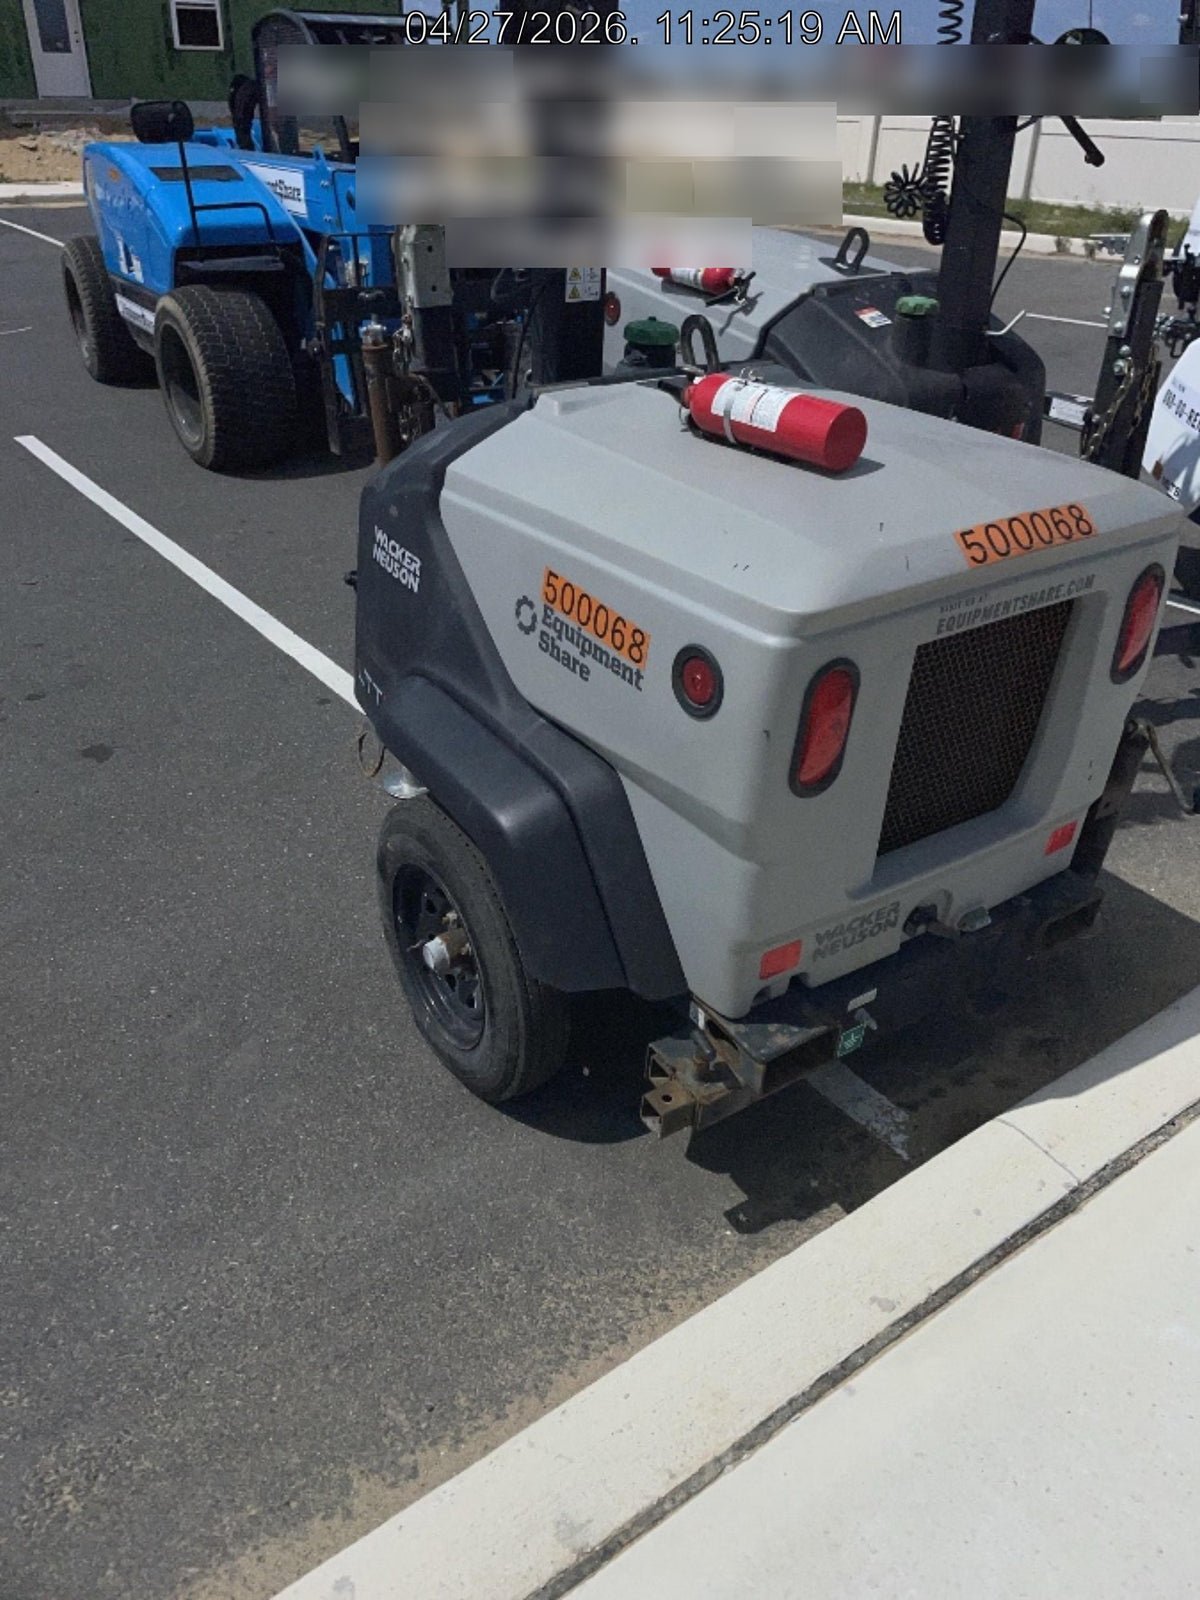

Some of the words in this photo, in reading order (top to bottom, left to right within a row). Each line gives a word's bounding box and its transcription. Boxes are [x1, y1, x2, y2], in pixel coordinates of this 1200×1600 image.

[374, 524, 422, 577] WACKER
[960, 504, 1094, 564] 500068
[372, 543, 420, 593] NEUSON
[543, 570, 647, 664] 500068
[937, 573, 1096, 636] EQUIPMENTSHARE.COM
[538, 630, 591, 683] Share
[541, 602, 645, 692] Equipment
[812, 914, 899, 961] NEUSON
[815, 901, 901, 945] WACKER
